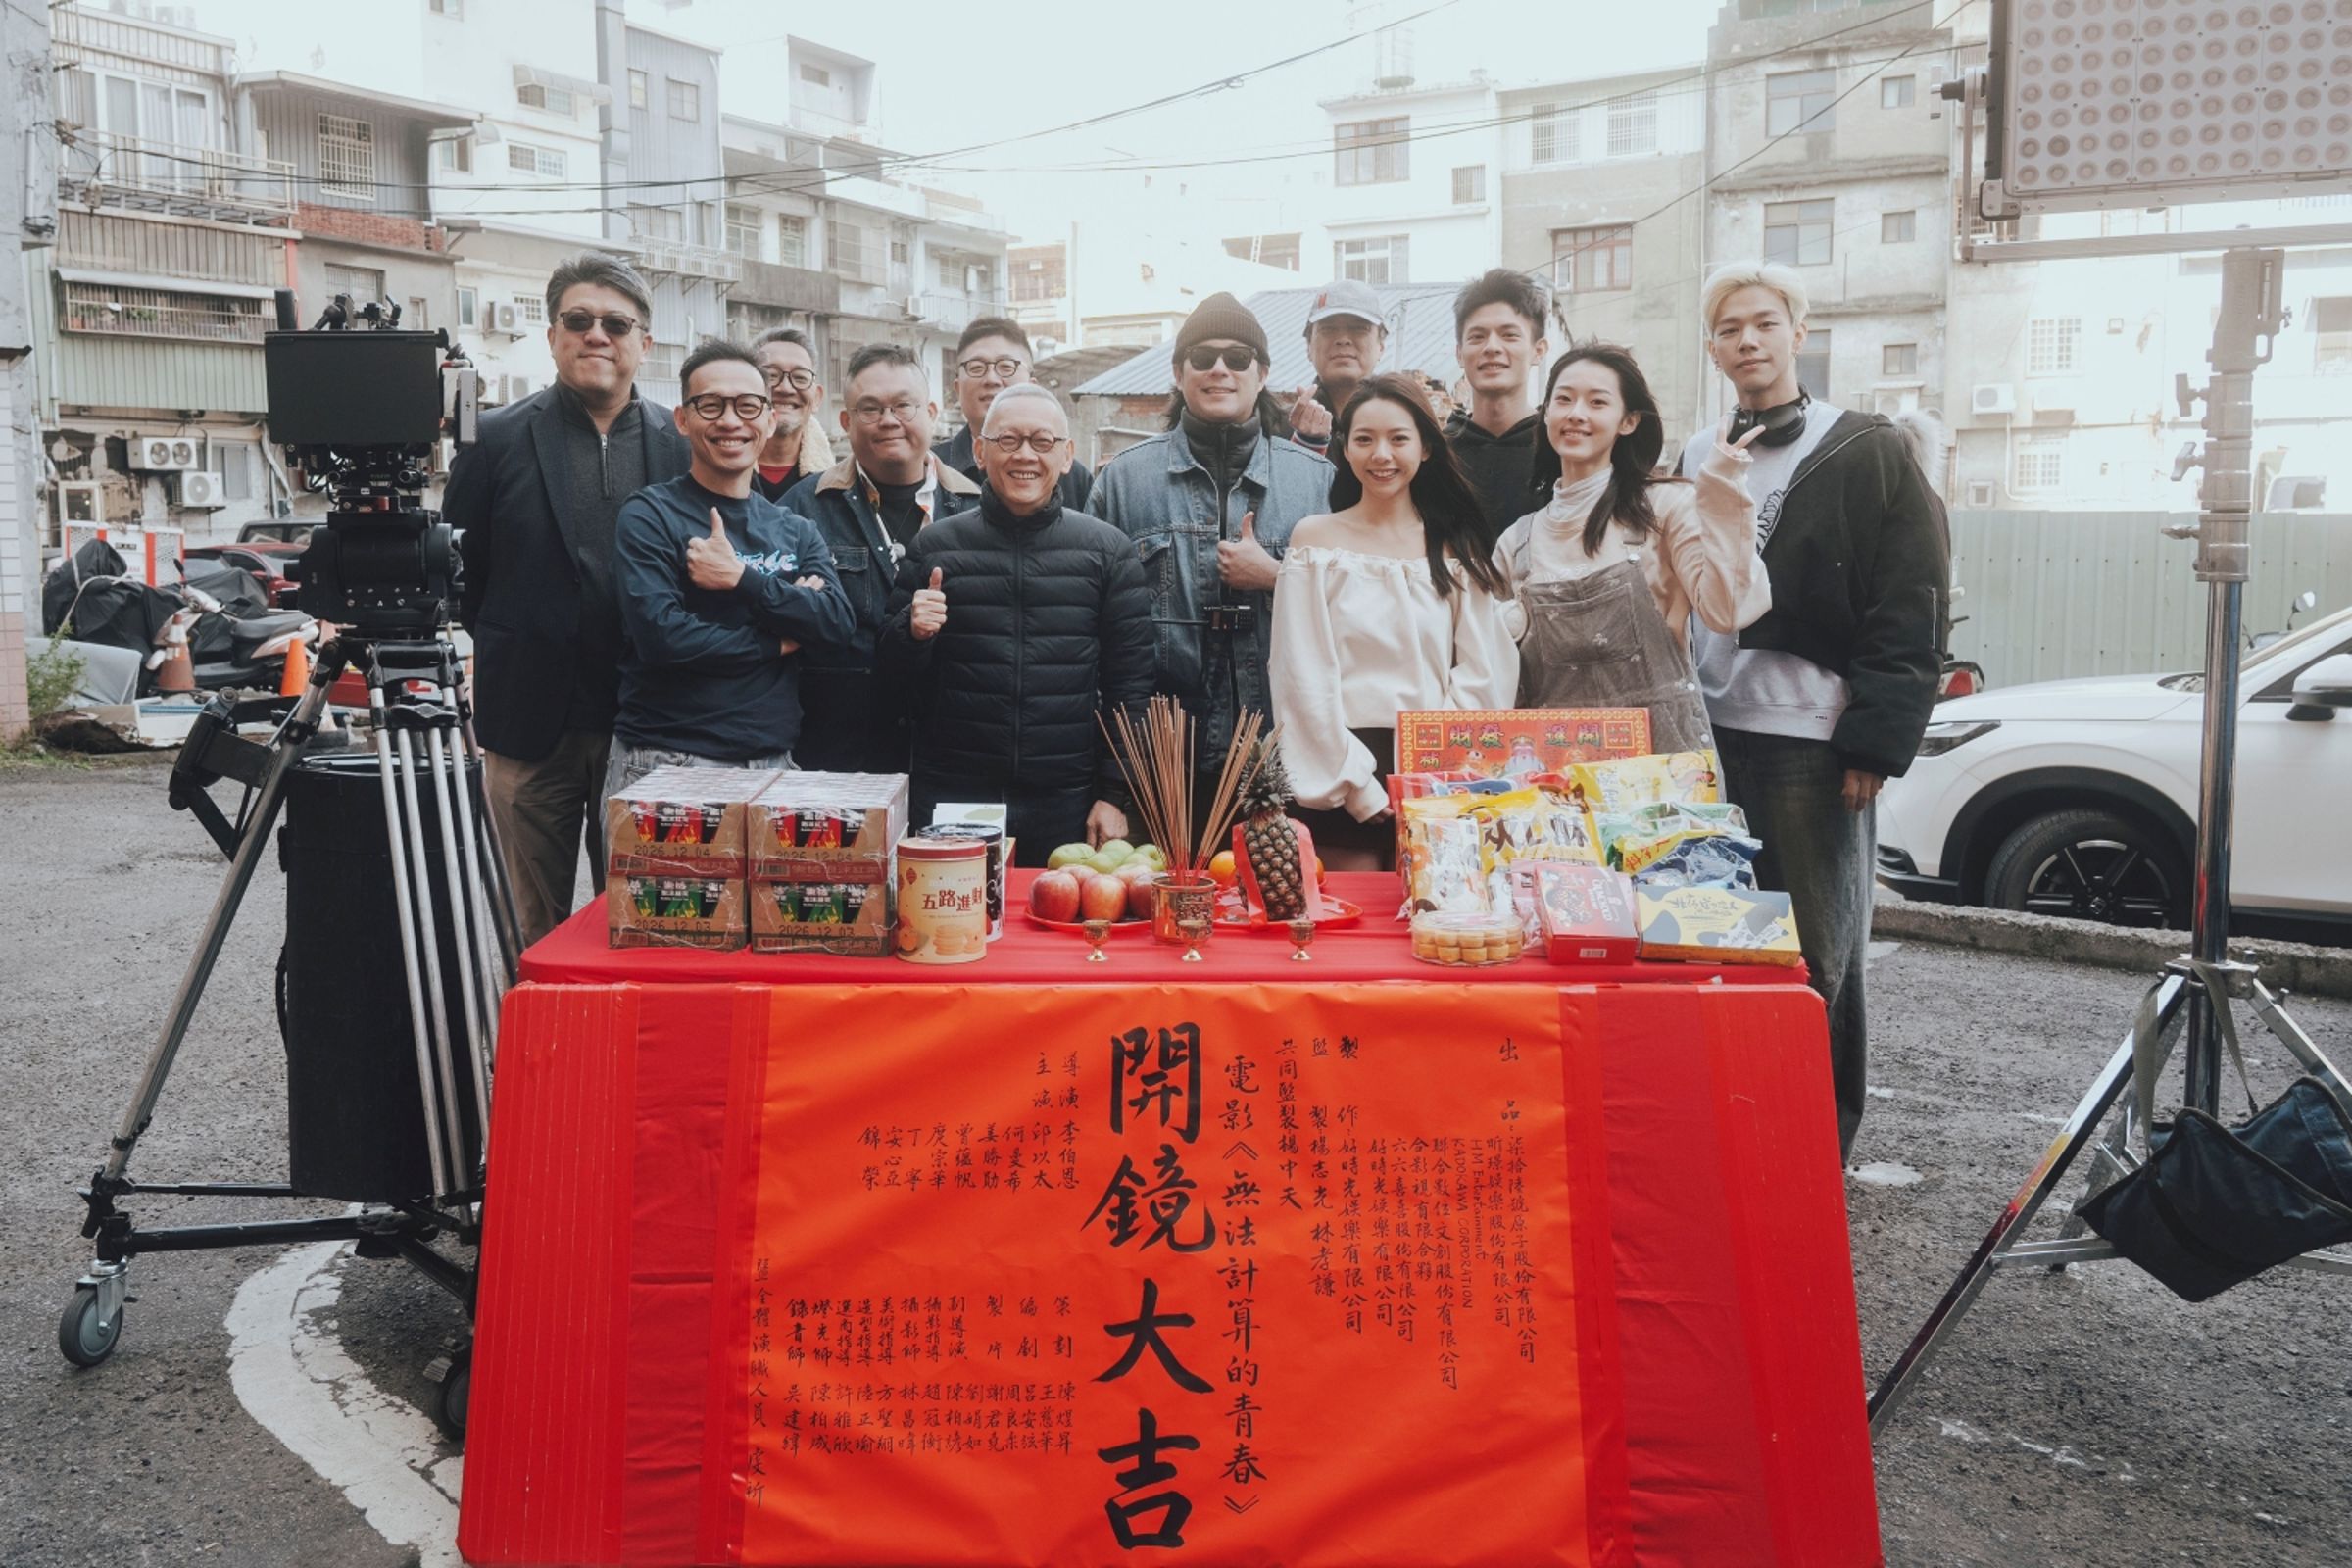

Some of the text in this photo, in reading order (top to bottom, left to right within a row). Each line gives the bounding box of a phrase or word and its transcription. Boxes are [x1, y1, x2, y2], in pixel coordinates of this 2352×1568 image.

[922, 886, 982, 912] 五路進財
[884, 1126, 903, 1187] 安心亞
[1452, 1138, 1469, 1211] KADOKAWA
[1080, 1022, 1215, 1550] 開鏡大吉
